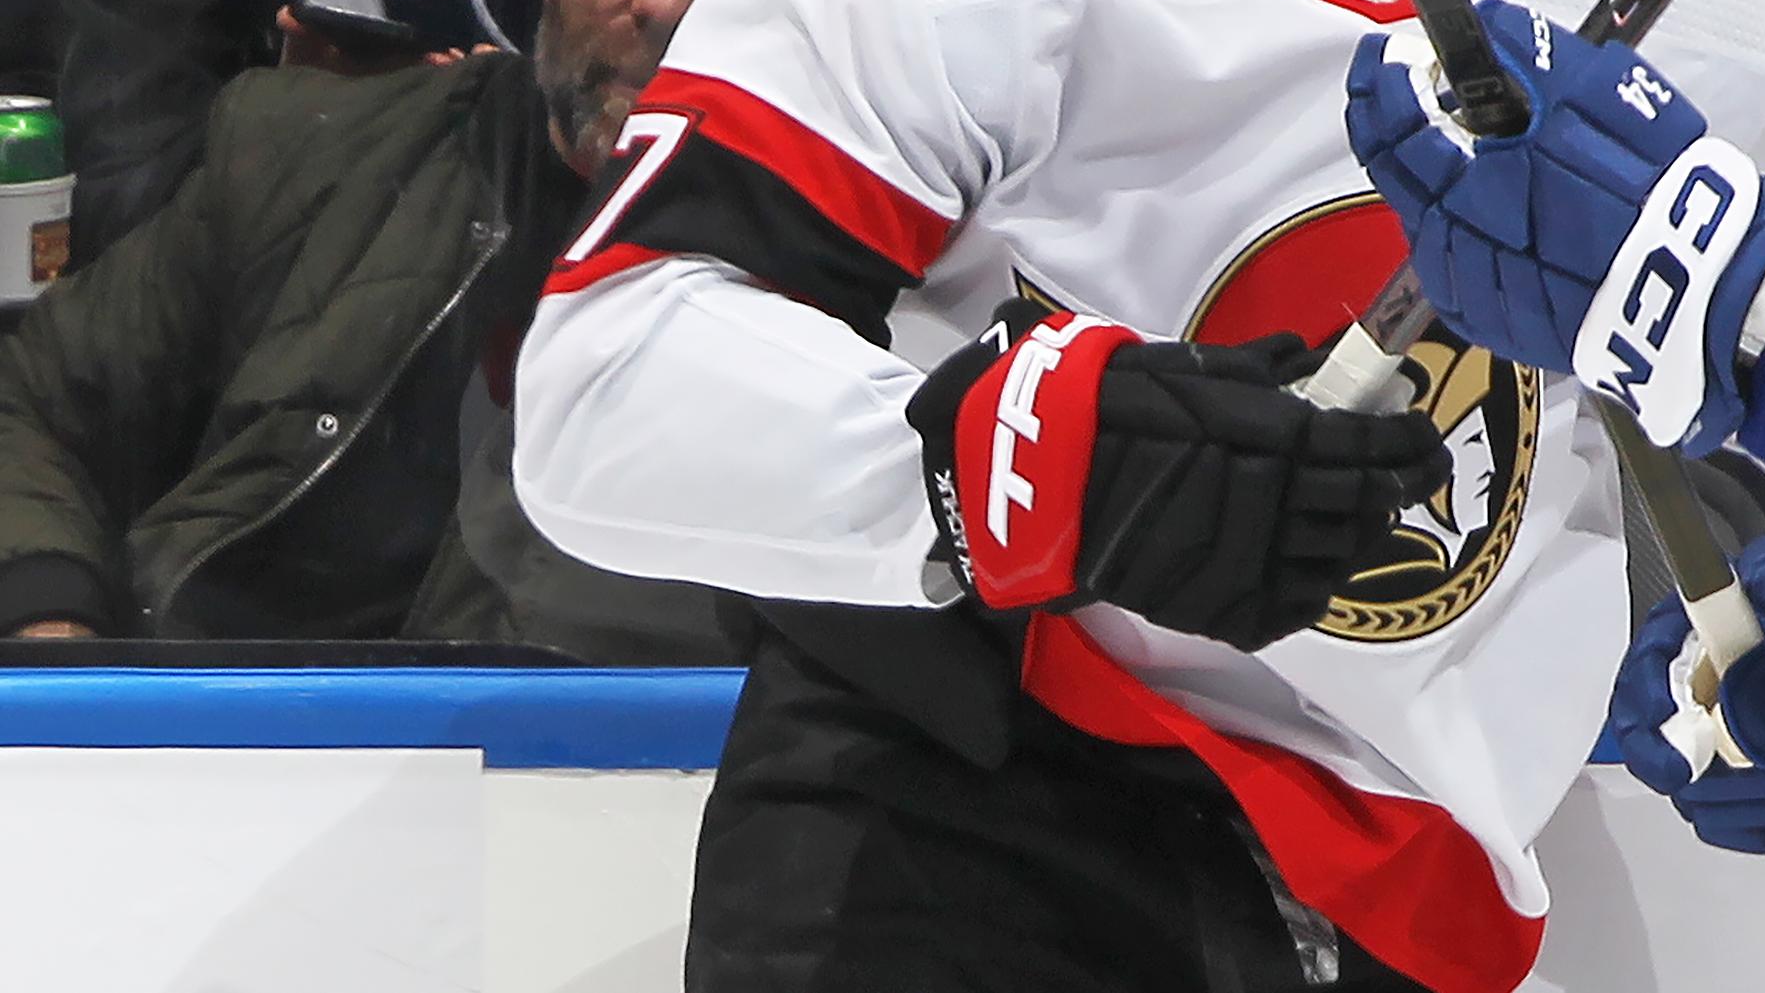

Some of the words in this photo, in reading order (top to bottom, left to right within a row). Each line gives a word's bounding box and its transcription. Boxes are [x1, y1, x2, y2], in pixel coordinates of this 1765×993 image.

[1616, 65, 1673, 121] 34
[558, 110, 694, 264] 7
[1596, 164, 1736, 417] CCM
